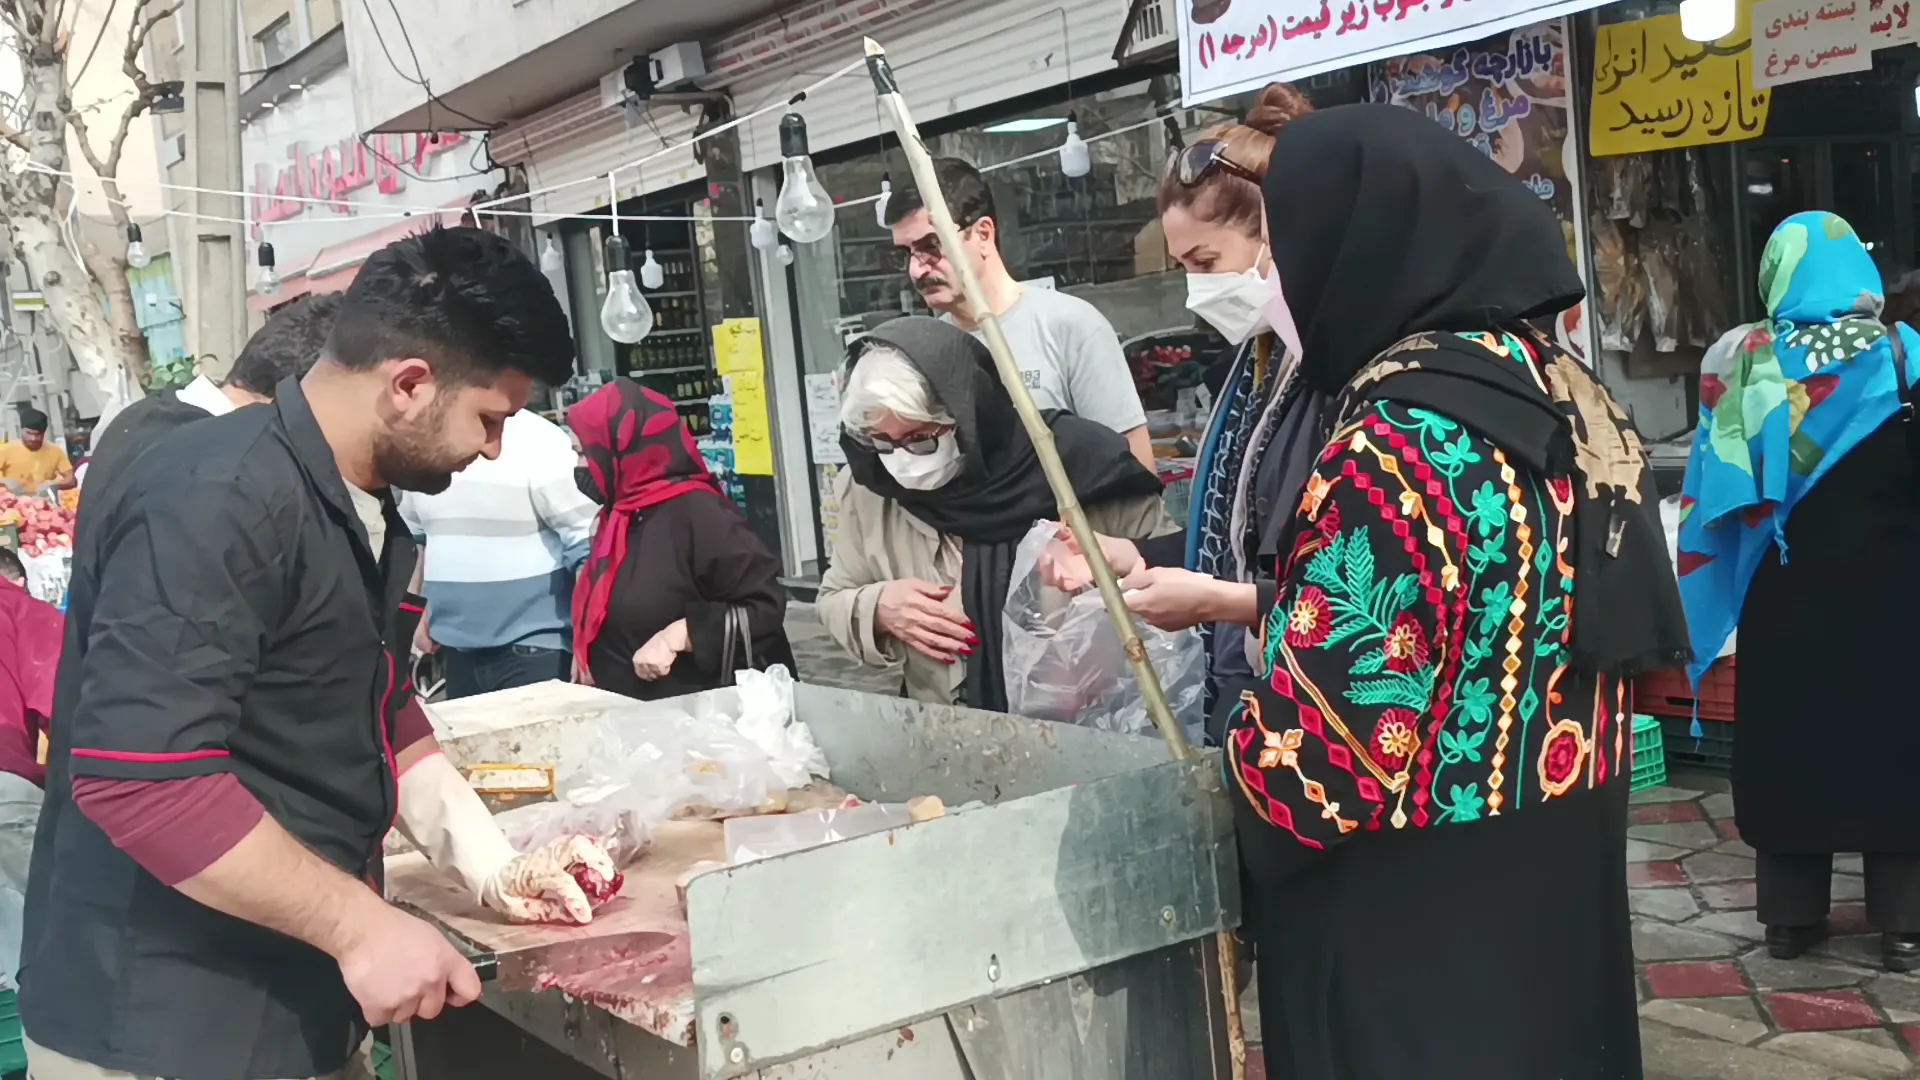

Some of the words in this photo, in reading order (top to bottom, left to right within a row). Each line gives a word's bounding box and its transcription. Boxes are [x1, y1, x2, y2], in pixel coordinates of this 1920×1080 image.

[1282, 0, 1331, 40] قیمت
[1473, 35, 1551, 84] بازارچه
[1764, 48, 1800, 78] مرغ
[1481, 89, 1530, 131] مرغ
[1608, 97, 1694, 138] رسید
